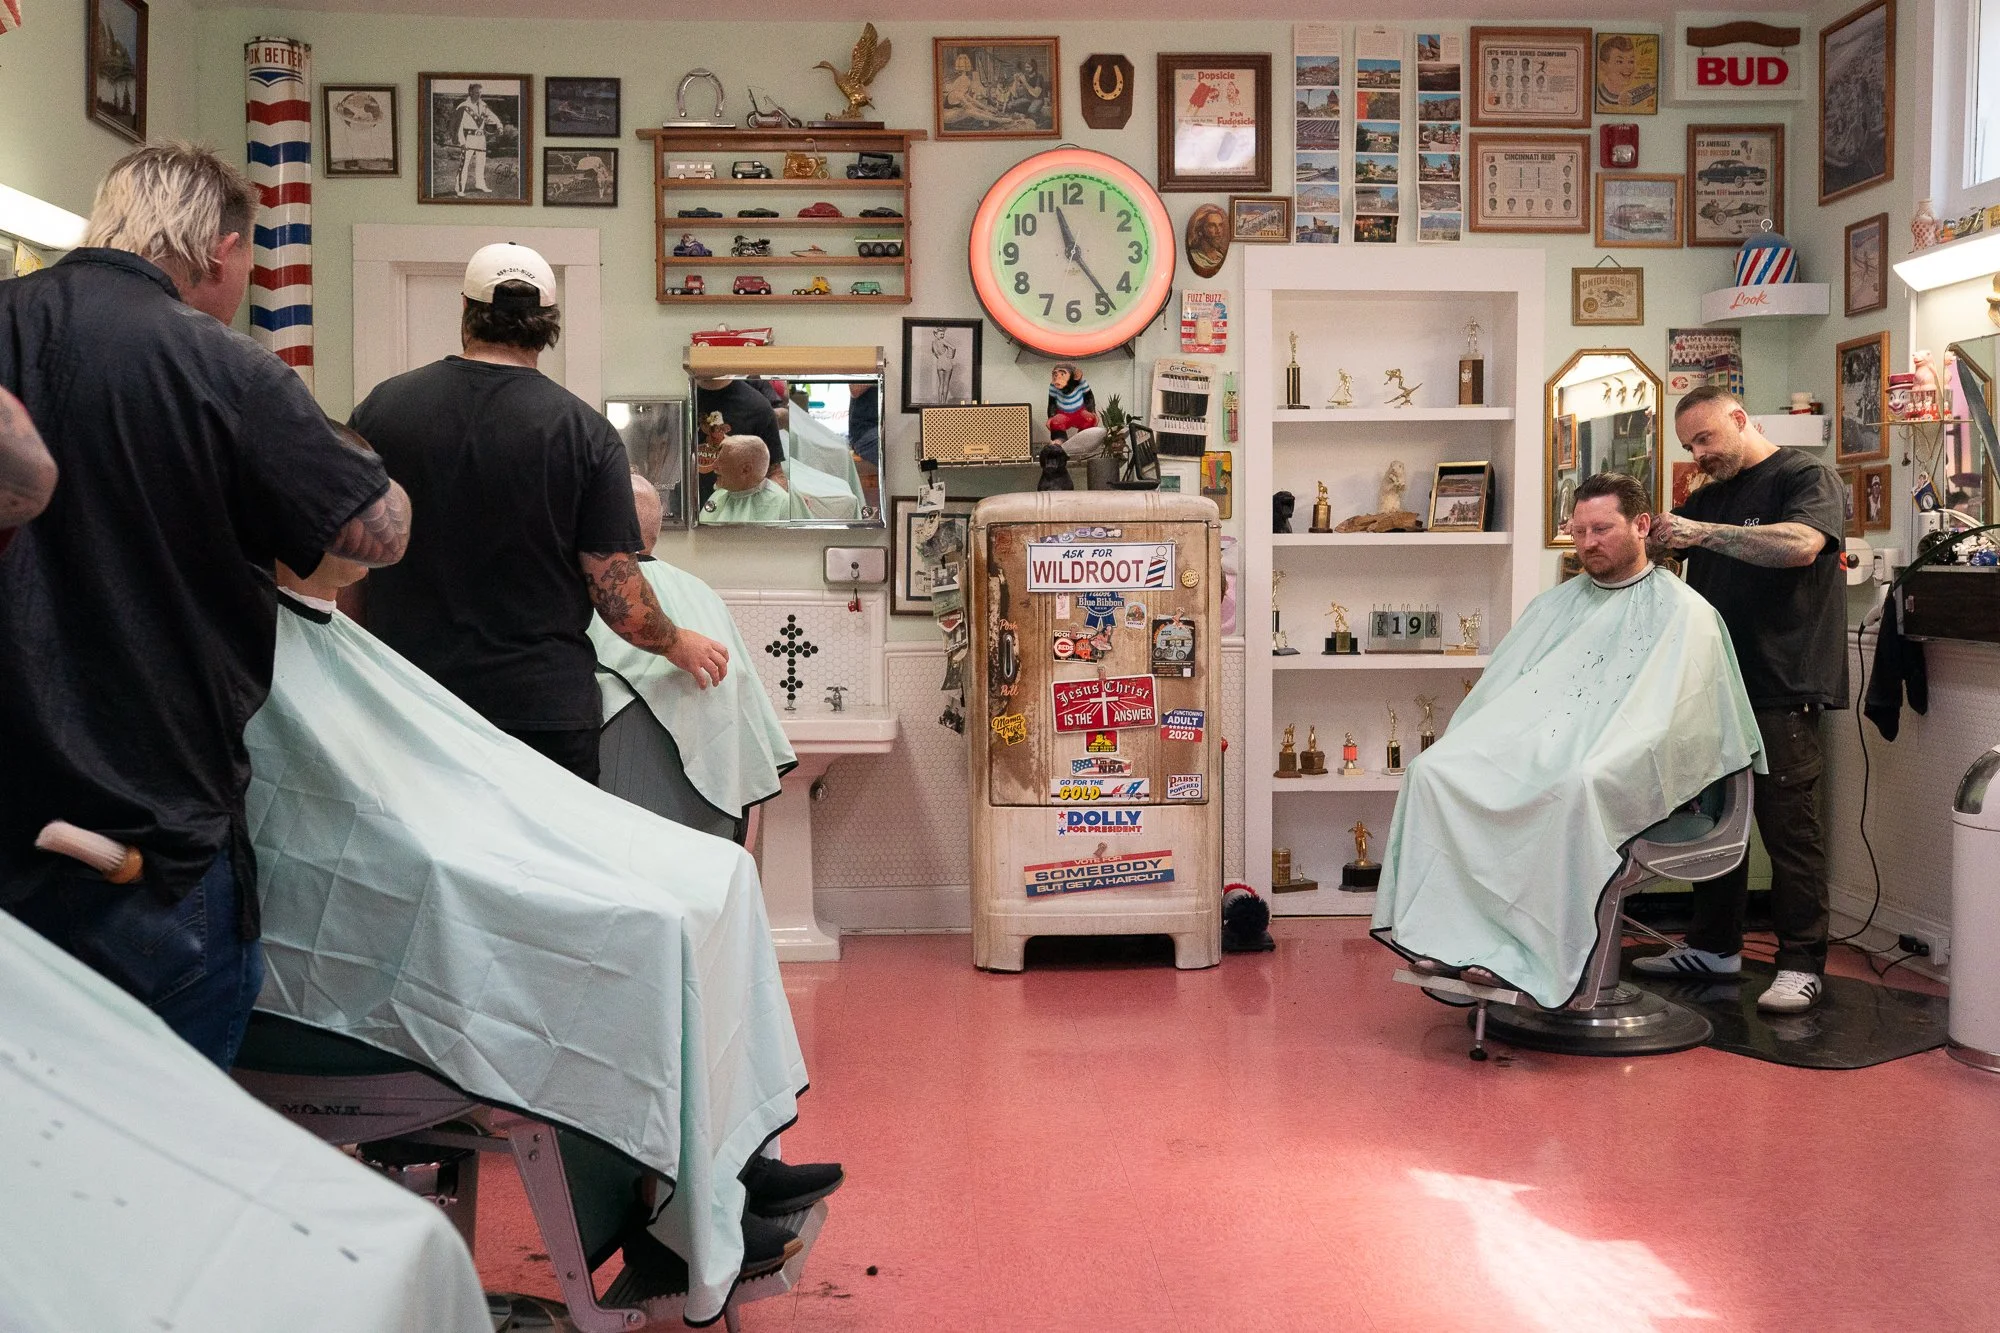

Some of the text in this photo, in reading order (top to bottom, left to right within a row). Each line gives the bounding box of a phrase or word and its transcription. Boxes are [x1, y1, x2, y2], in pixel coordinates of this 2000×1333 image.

[265, 48, 302, 69] BETTER
[1198, 71, 1235, 82] Popsicle
[1697, 57, 1789, 86] BUD
[1504, 153, 1556, 161] CINCINNATI REDS
[1039, 191, 1054, 213] 11
[1062, 182, 1084, 205] 12
[1099, 191, 1105, 212] 1
[1014, 213, 1037, 236] 10
[1116, 209, 1132, 232] 2
[1003, 242, 1020, 265] 9
[1127, 240, 1143, 264] 3
[1014, 271, 1030, 295] 8
[1116, 271, 1132, 294] 4
[1582, 277, 1608, 290] UNION
[1038, 293, 1054, 316] 7
[1095, 292, 1110, 316] 5
[1187, 293, 1222, 303] FUZZ BUZZ
[1729, 290, 1770, 311] Look
[1065, 300, 1082, 323] 6
[1063, 548, 1113, 559] ASK FOR
[1032, 559, 1144, 584] WILDROOT
[1078, 597, 1123, 607] Blue Ribbon
[1392, 616, 1422, 635] 19
[1000, 684, 1019, 696] Pull
[1057, 681, 1150, 707] Jesus Christ
[1064, 714, 1074, 726] IS
[1075, 713, 1093, 725] THE
[1114, 708, 1152, 722] ANSWER
[1167, 716, 1199, 726] ADULT
[1168, 730, 1195, 740] 2020
[1098, 764, 1124, 773] NRA
[1169, 776, 1199, 788] PABST
[1169, 782, 1199, 794] POWERED
[1060, 785, 1101, 800] GOLD
[1067, 811, 1142, 826] DOLLY
[1066, 825, 1142, 833] FOR PRESIDENT
[1101, 855, 1122, 863] FOR
[1035, 858, 1163, 882] SOMEBODY
[1036, 882, 1064, 893] BUT
[1066, 879, 1093, 890] GET
[1105, 872, 1164, 885] HAIRCUT
[280, 1104, 361, 1115] MONT
